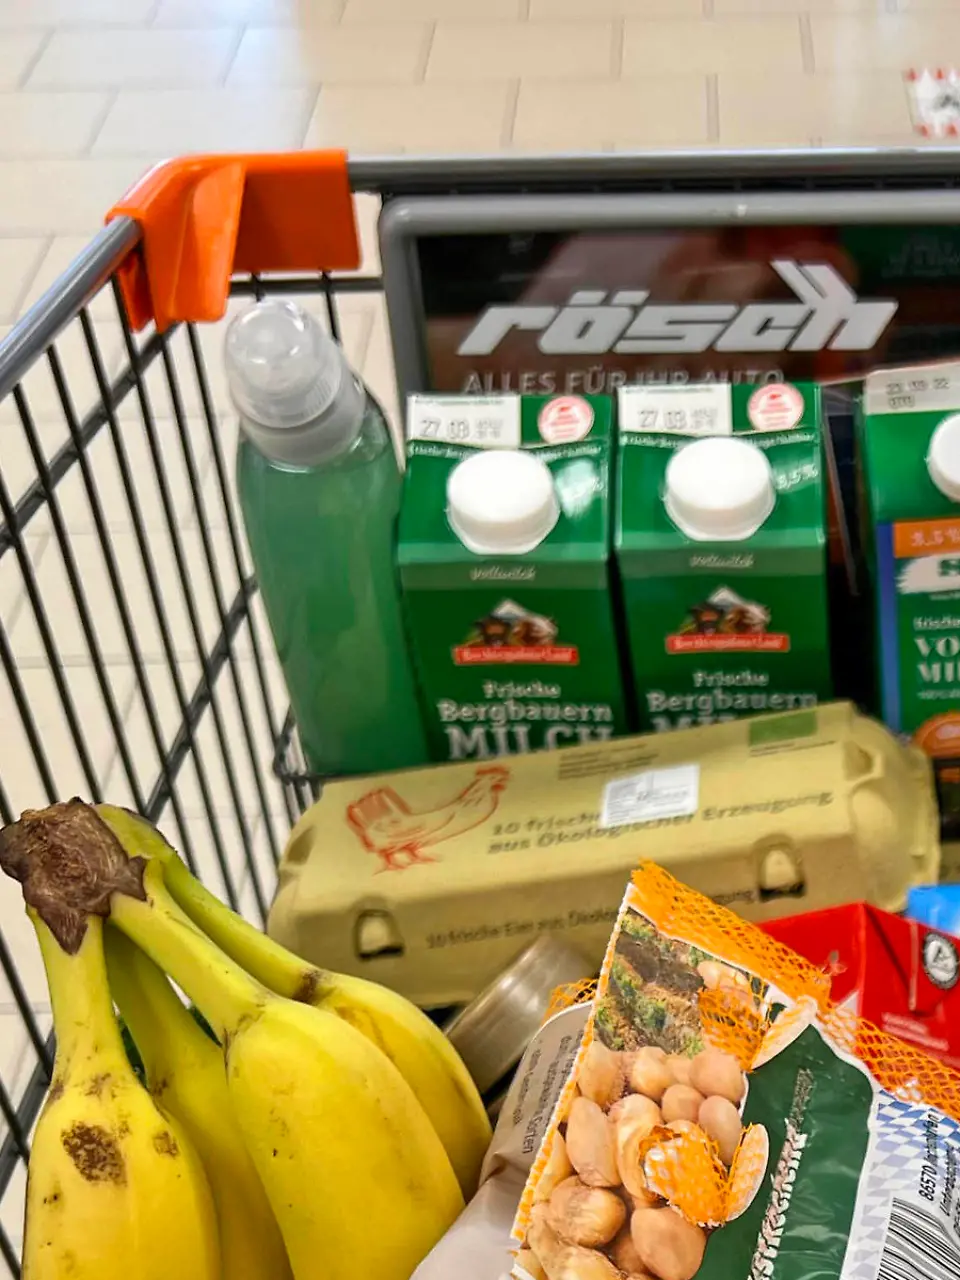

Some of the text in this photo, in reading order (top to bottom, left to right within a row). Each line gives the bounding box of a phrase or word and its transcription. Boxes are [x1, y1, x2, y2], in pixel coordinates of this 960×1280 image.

[457, 259, 899, 356] rösch
[463, 369, 557, 396] ALLES
[438, 699, 613, 726] Bergbauern
[647, 687, 818, 713] Bergbauern
